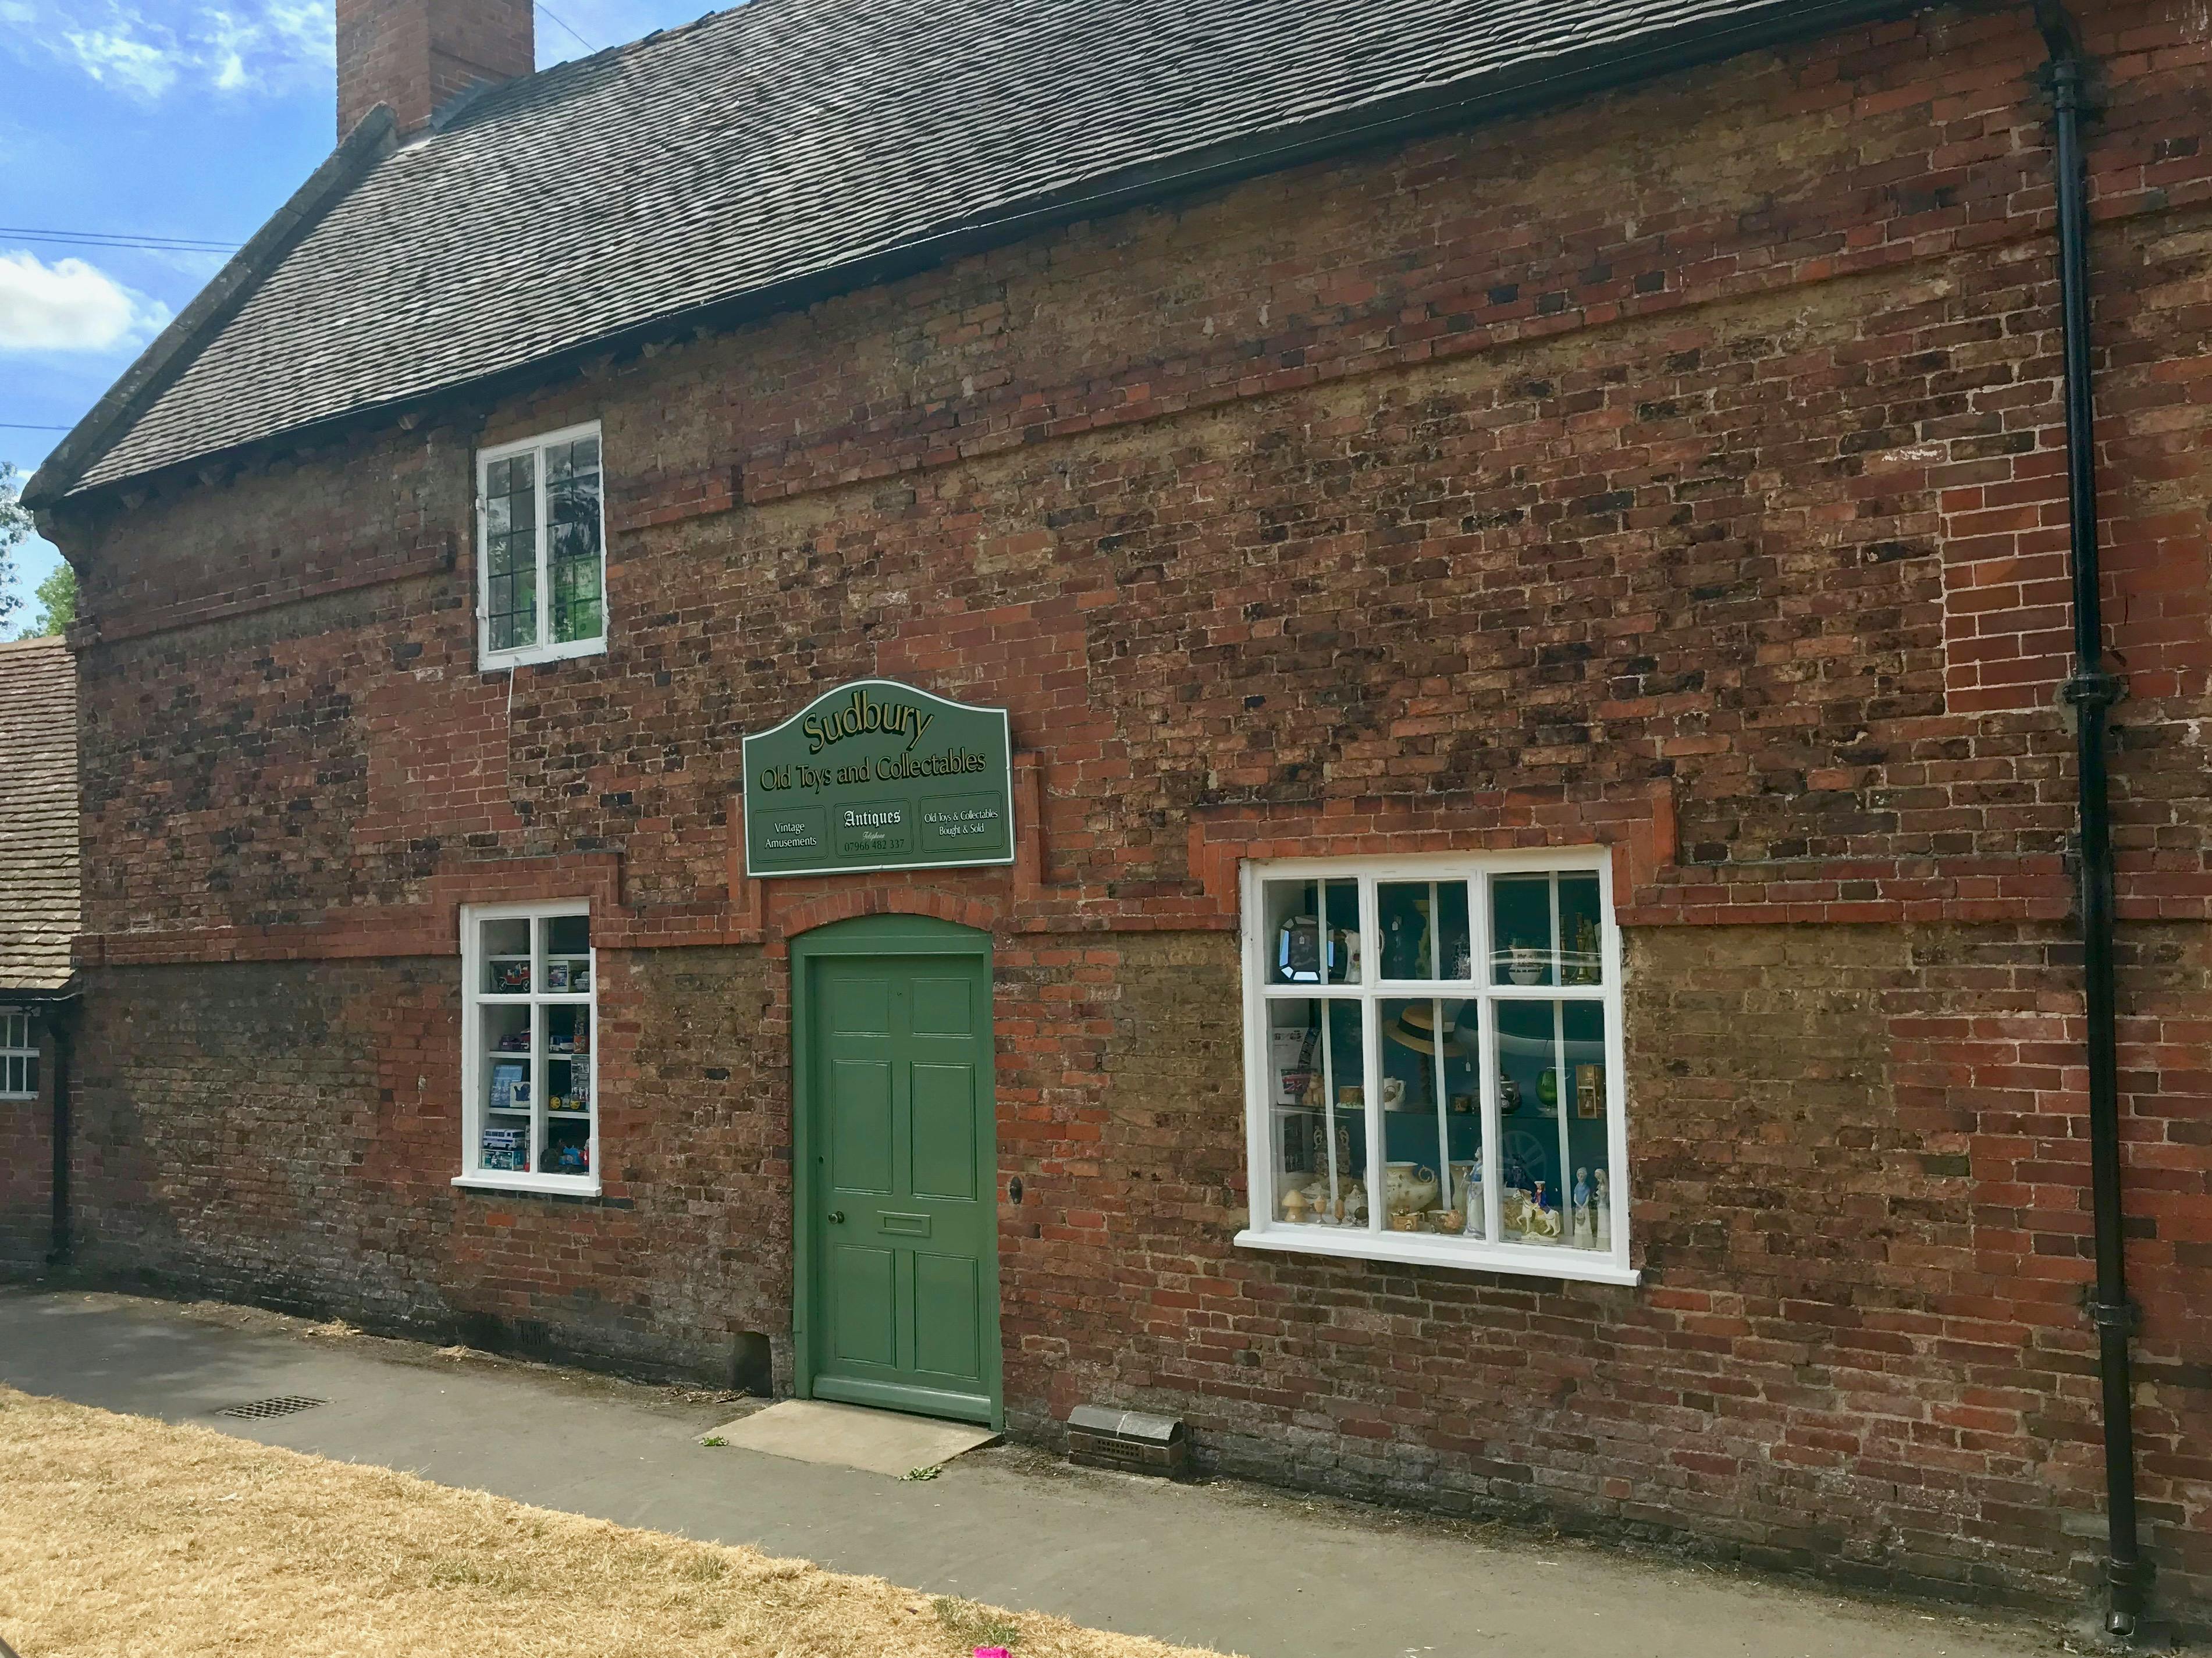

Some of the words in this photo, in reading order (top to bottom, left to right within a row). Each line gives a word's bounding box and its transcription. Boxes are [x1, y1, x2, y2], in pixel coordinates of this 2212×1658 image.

[803, 689, 934, 754] Sudbury
[760, 764, 791, 791] Old
[796, 764, 832, 794] Toys
[837, 756, 870, 784] and
[876, 746, 987, 780] Collectables
[844, 810, 901, 827] Antiques
[924, 813, 937, 823] Old
[938, 813, 952, 825] Toys
[953, 812, 959, 821] &
[960, 809, 998, 821] Collectables
[774, 822, 805, 835] Vintage
[939, 825, 961, 838] Bought
[962, 825, 969, 834] &
[970, 823, 984, 833] Sold
[765, 837, 817, 849] Amusements
[844, 841, 870, 852] 07966
[872, 840, 887, 849] 482
[890, 839, 905, 849] 337
